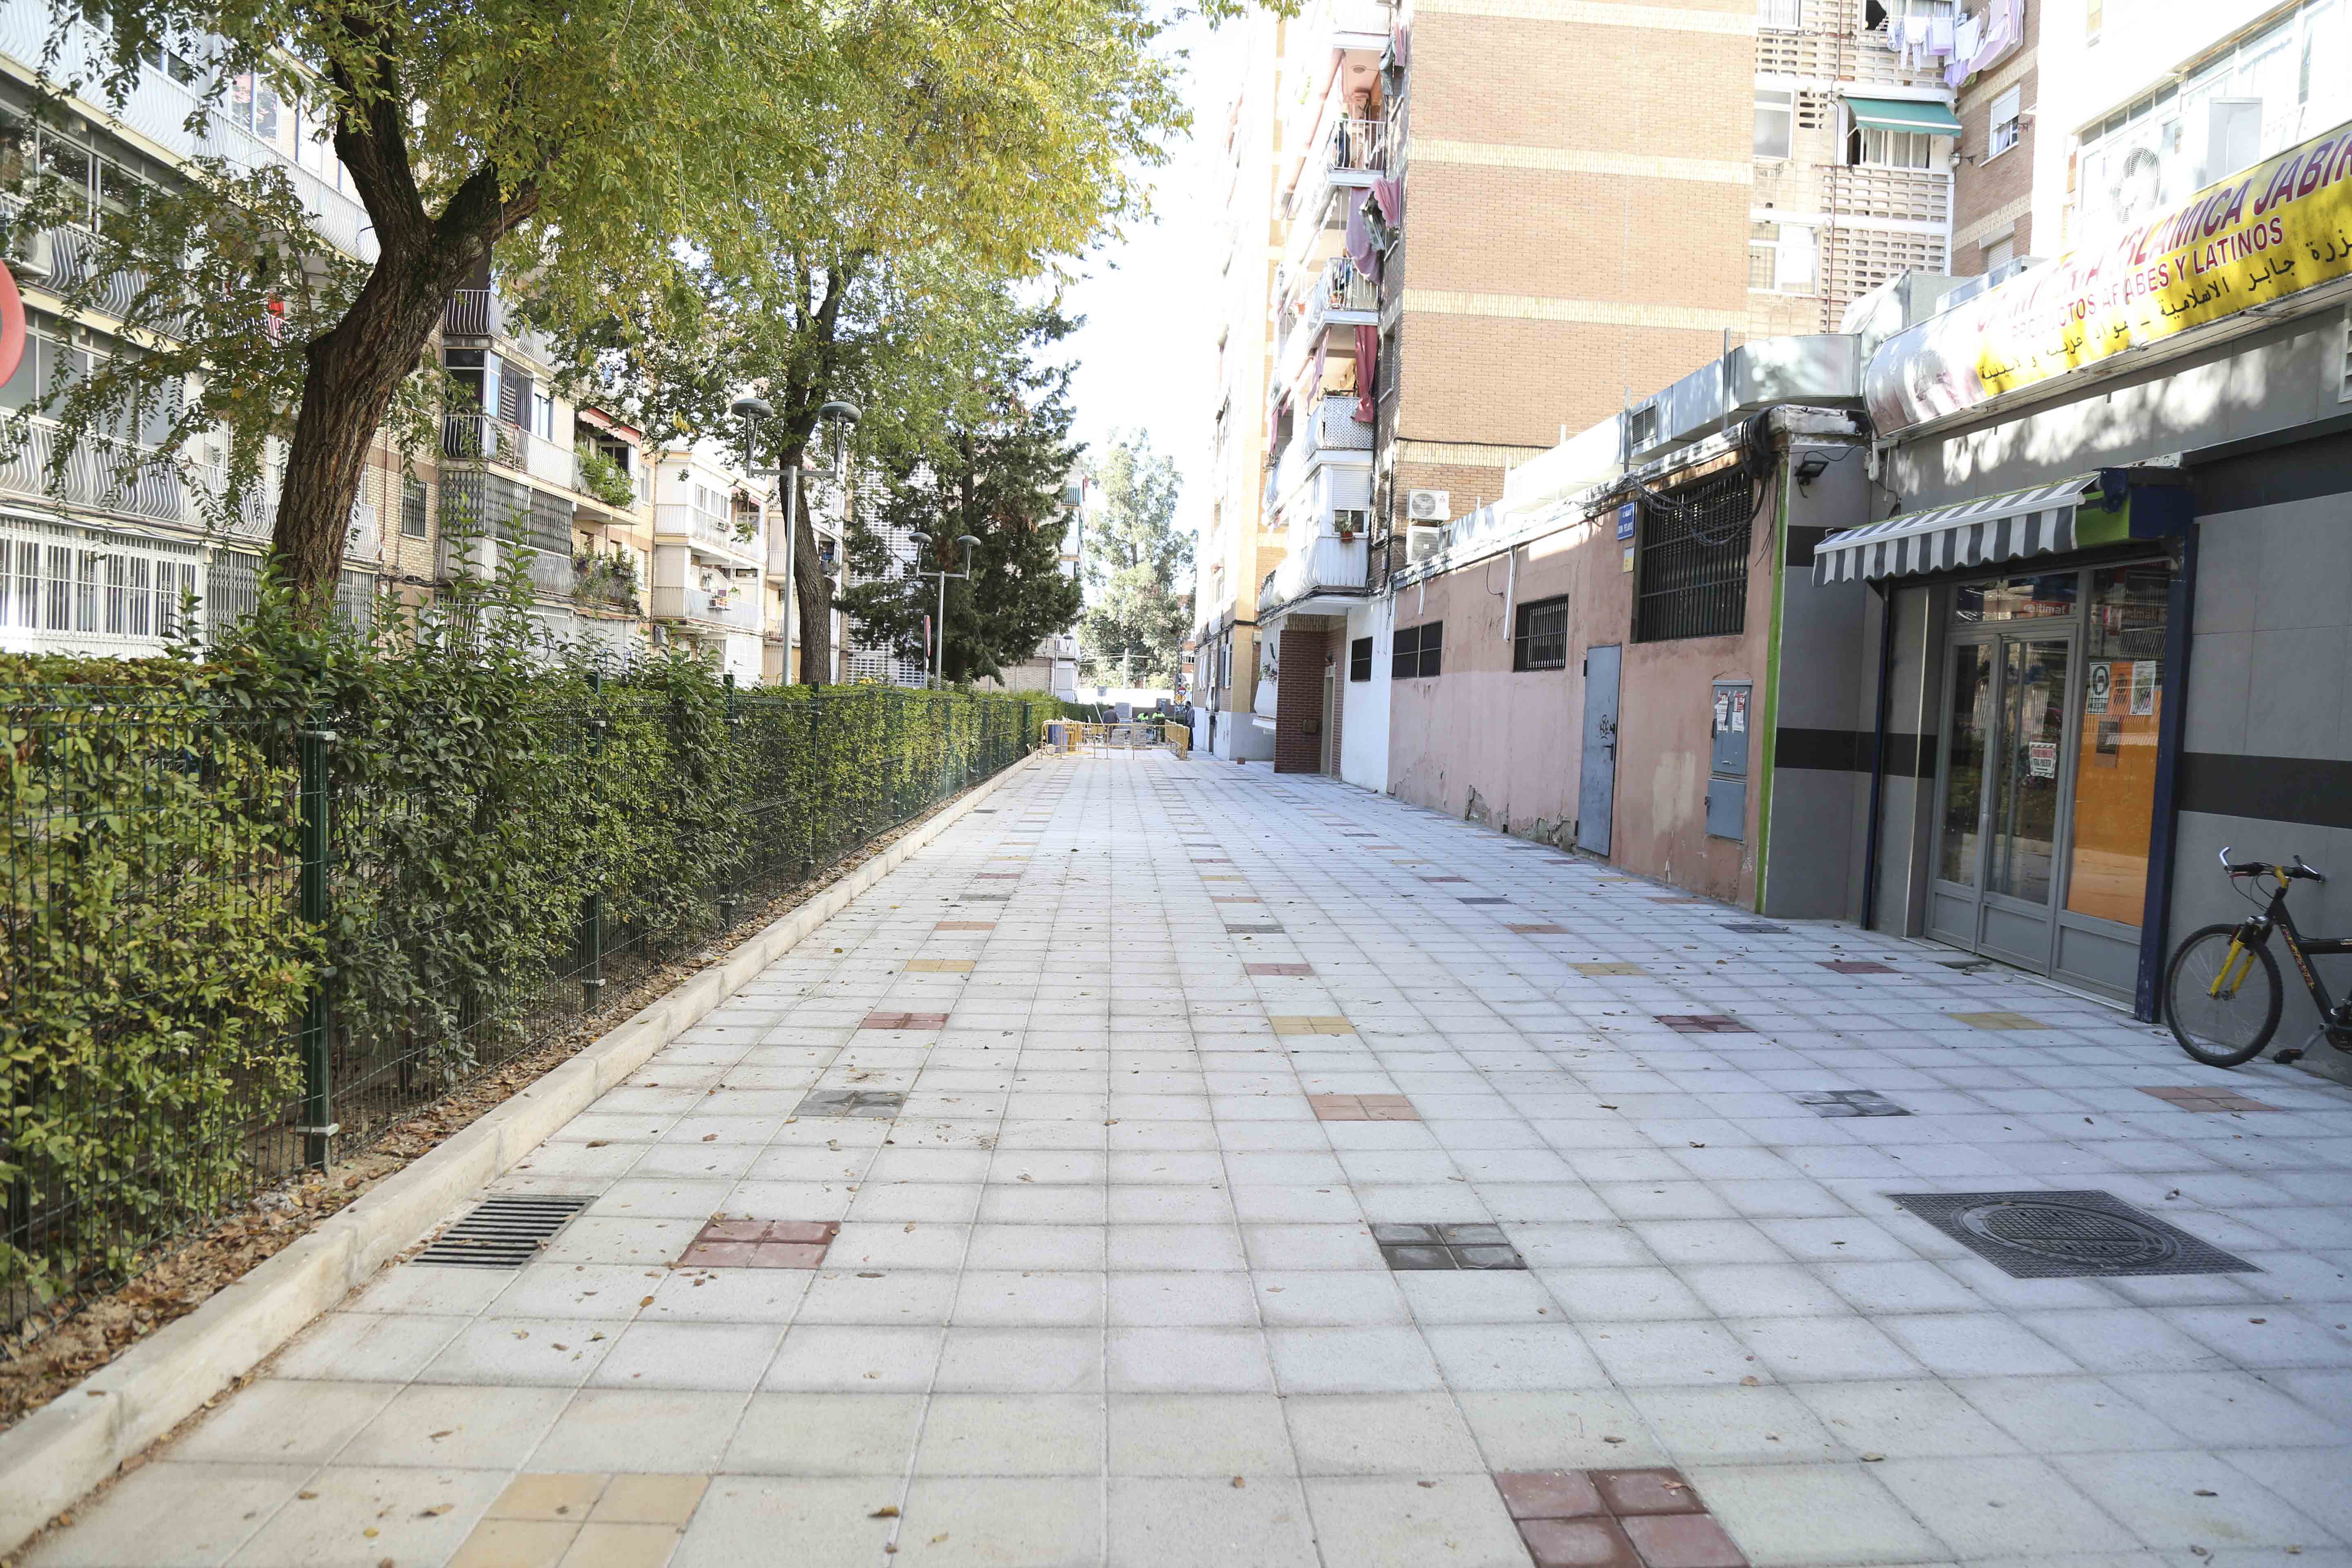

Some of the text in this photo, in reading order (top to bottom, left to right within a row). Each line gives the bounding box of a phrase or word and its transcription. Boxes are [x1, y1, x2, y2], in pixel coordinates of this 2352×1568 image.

[2175, 255, 2186, 281] Y
[2193, 217, 2283, 275] LATINOS
[2248, 258, 2295, 292] جابر
